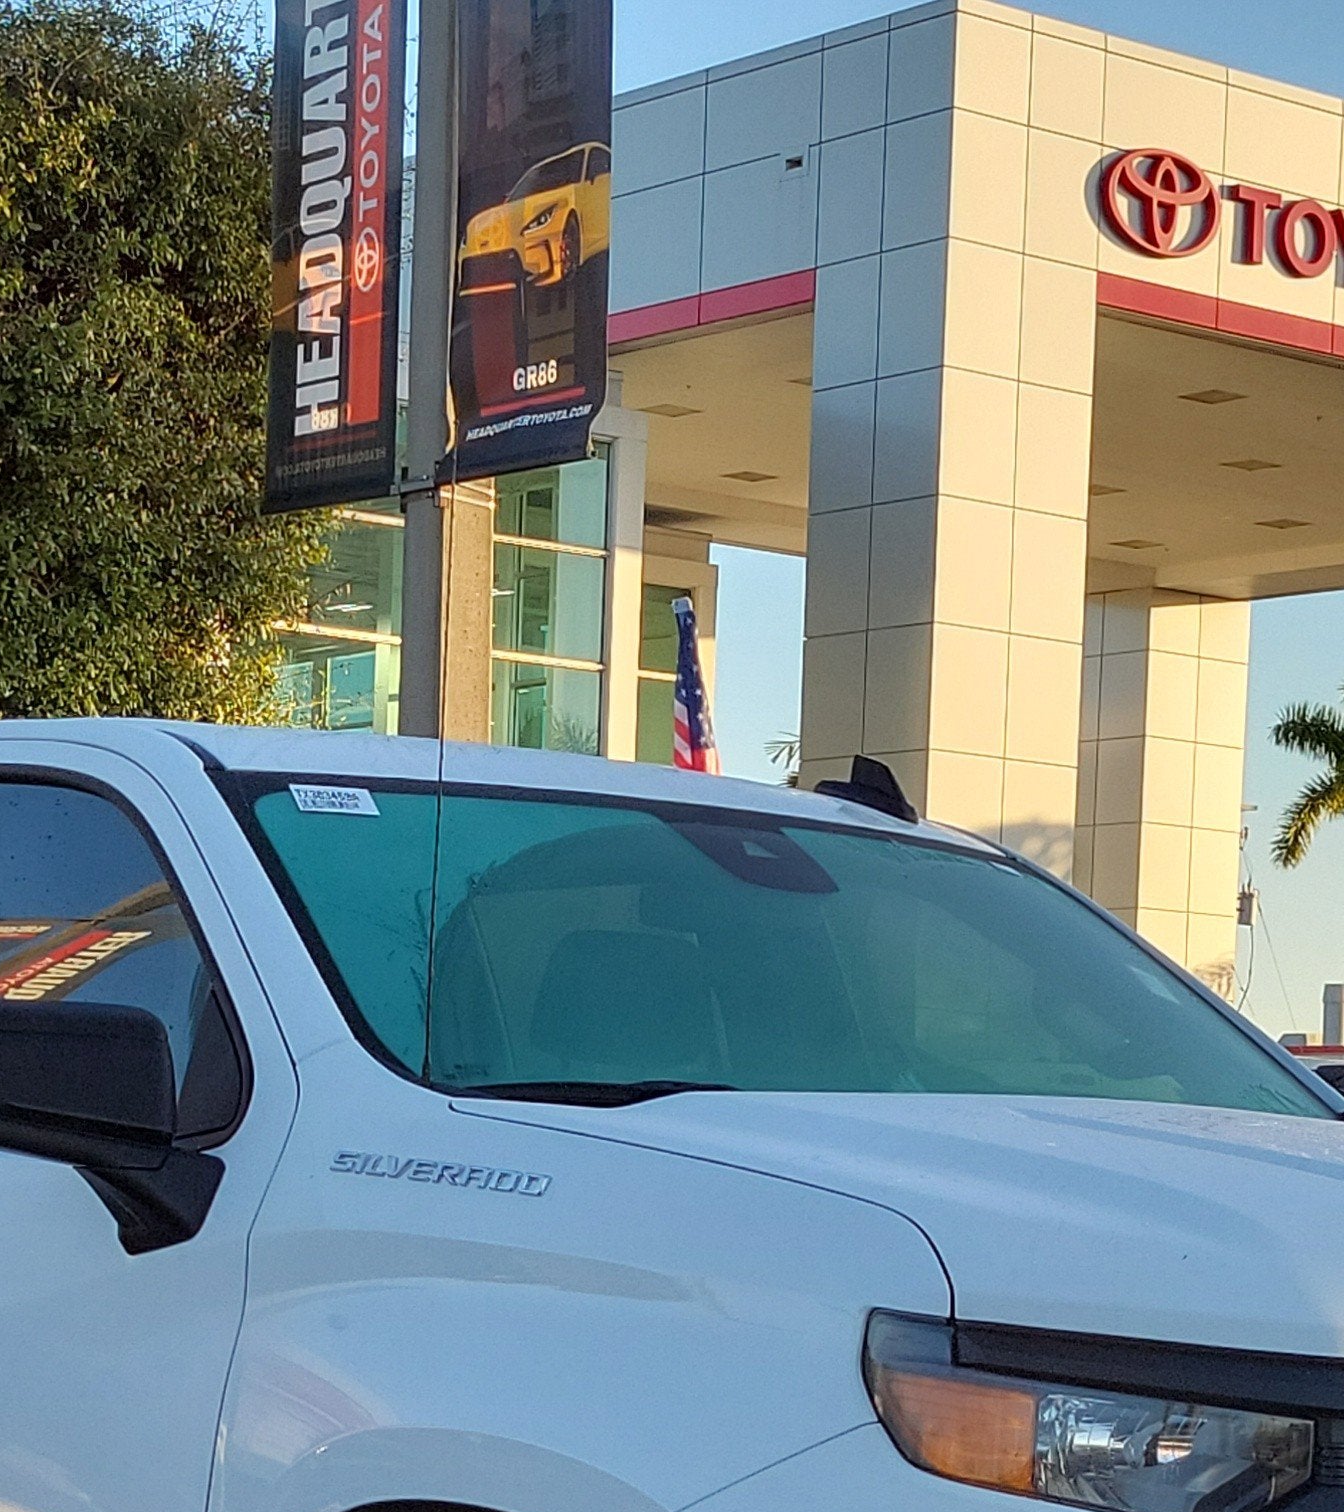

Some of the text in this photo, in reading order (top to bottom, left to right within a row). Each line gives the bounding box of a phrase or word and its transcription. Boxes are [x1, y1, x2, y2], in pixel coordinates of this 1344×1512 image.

[359, 4, 384, 223] TOYOTA
[513, 359, 558, 391] GR86
[330, 1150, 552, 1197] SILVERADO
